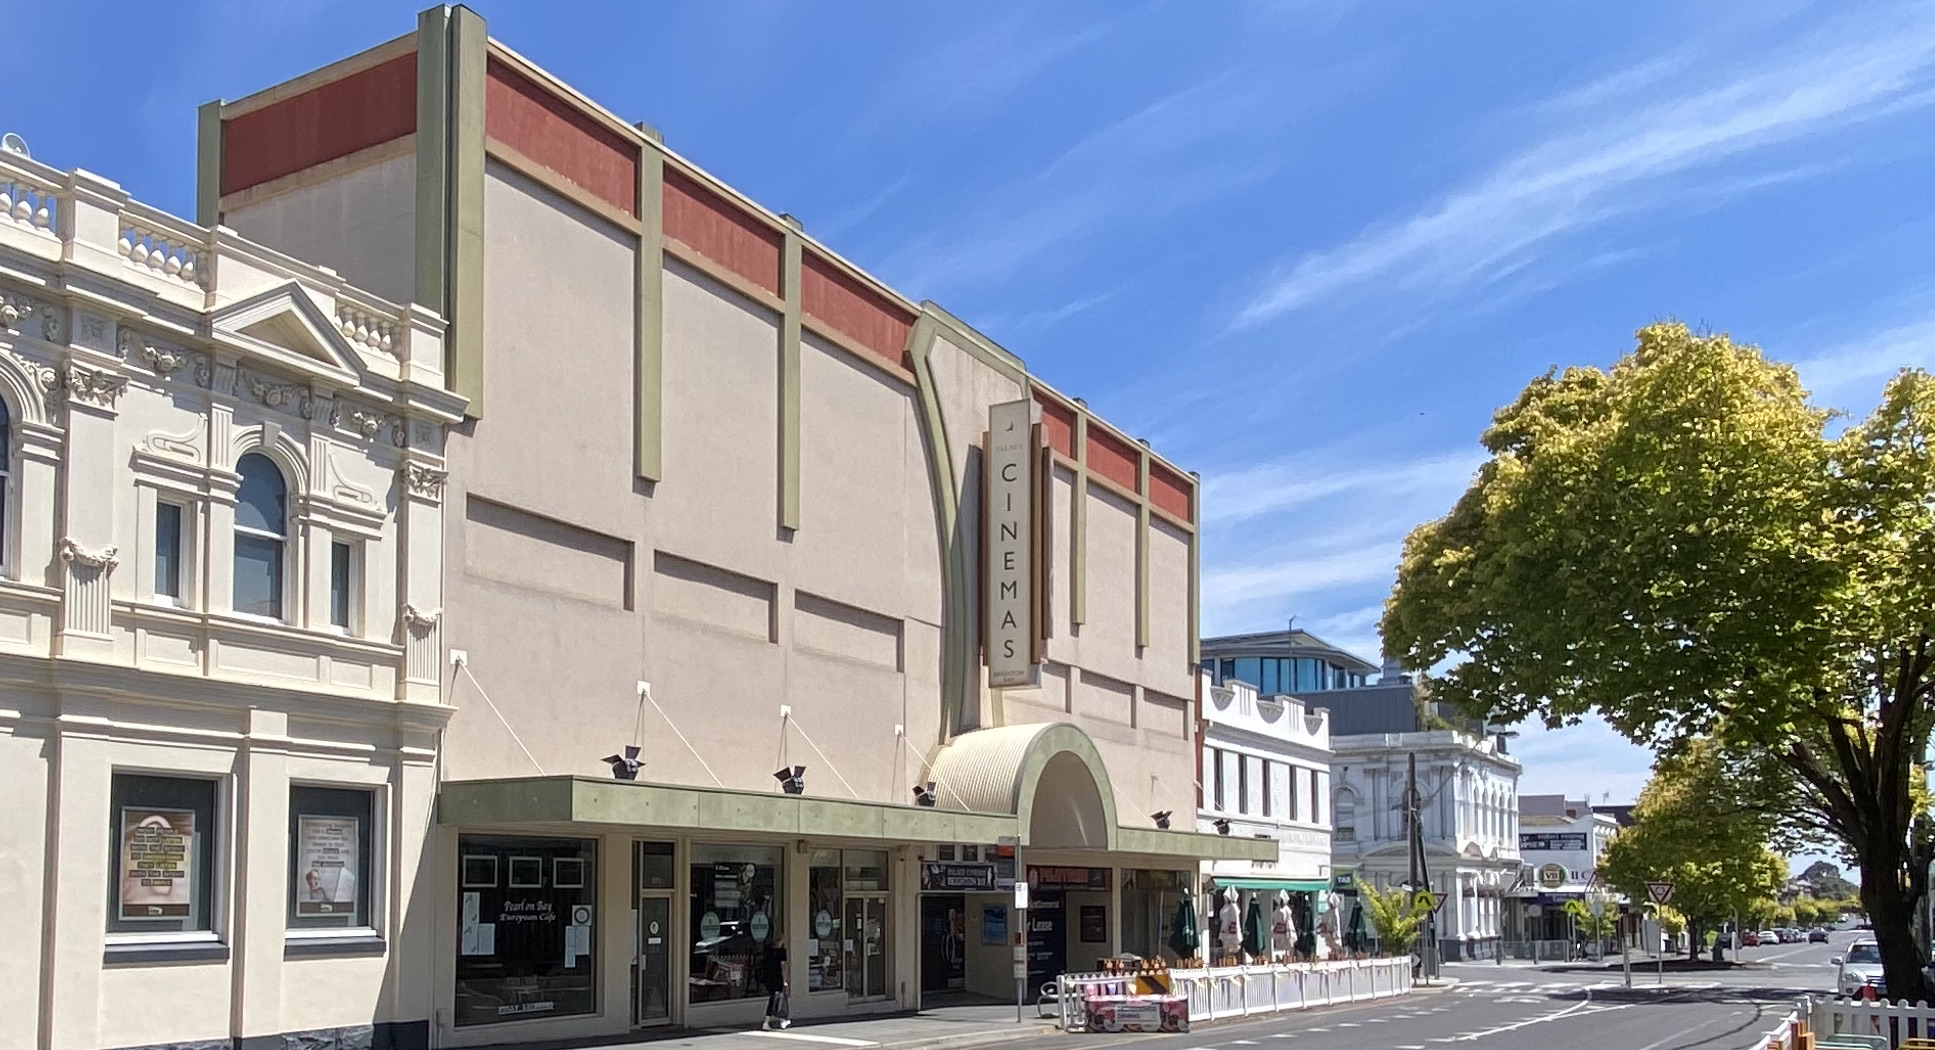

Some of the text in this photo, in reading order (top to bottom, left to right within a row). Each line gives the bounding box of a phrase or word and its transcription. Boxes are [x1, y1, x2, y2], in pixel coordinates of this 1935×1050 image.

[1000, 462, 1018, 659] CINEMAS
[503, 897, 553, 913] Pearl on Bay
[499, 913, 538, 924] European
[1032, 917, 1053, 932] Lease
